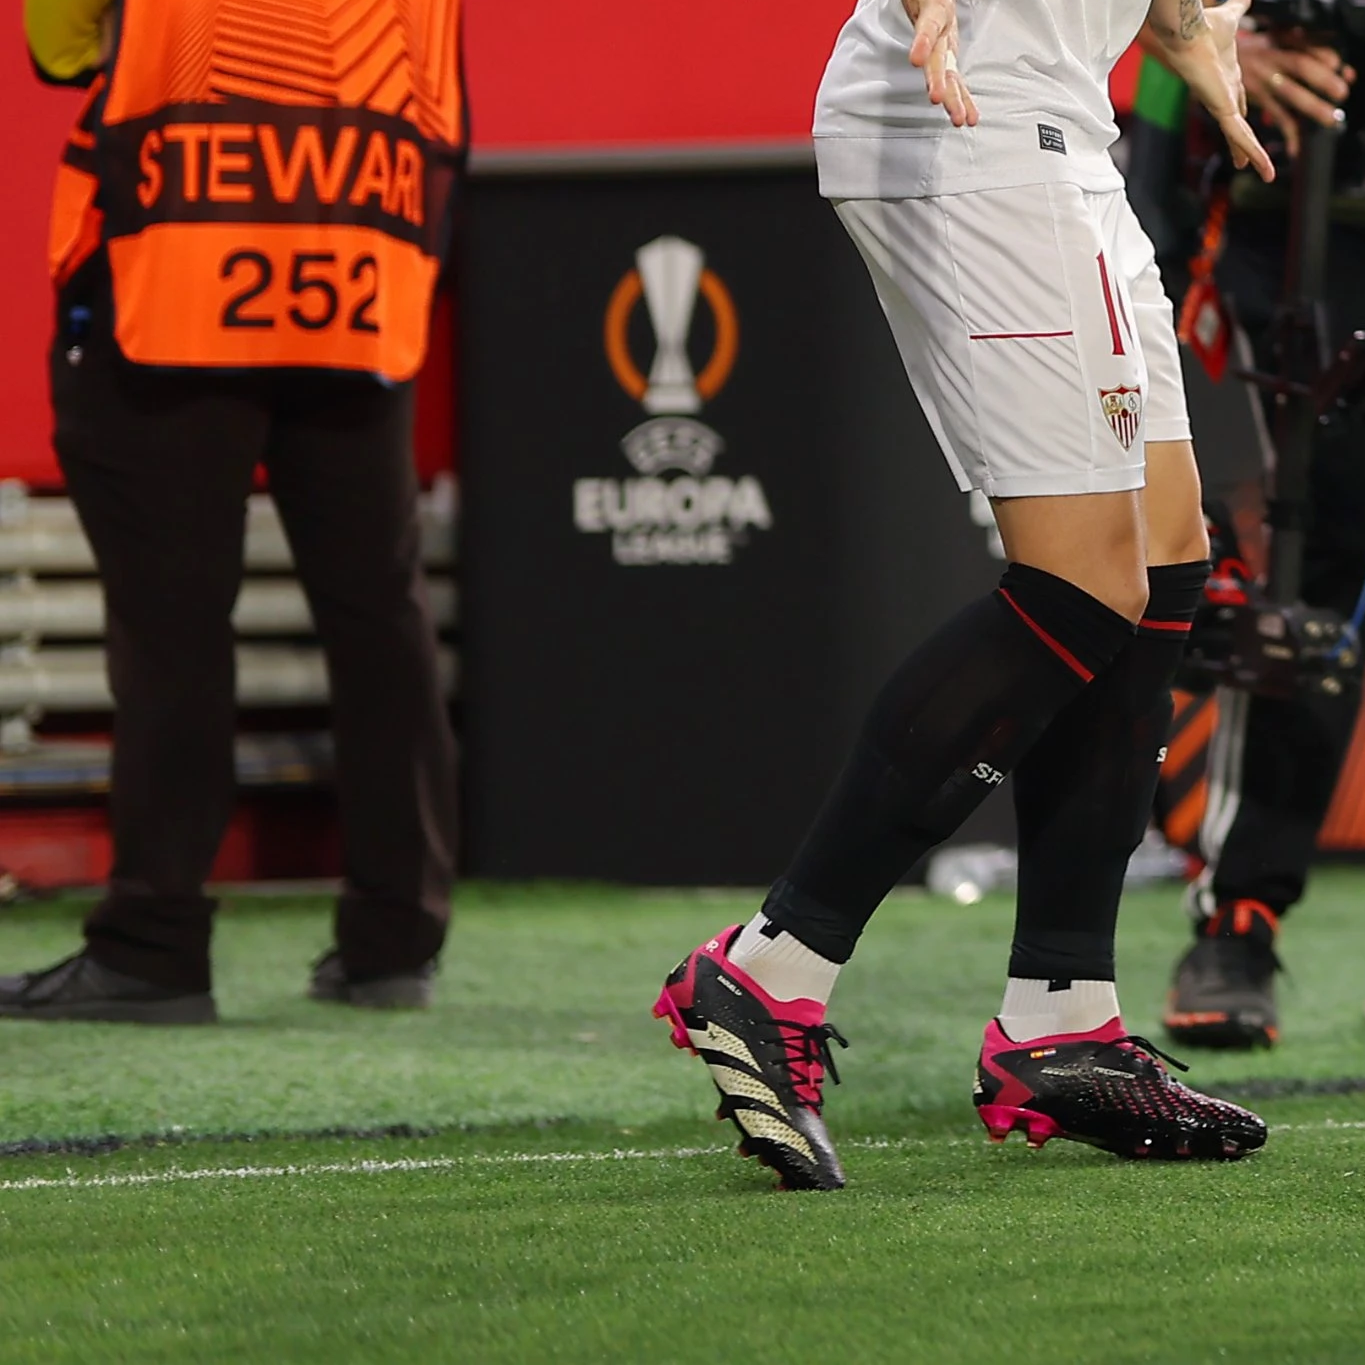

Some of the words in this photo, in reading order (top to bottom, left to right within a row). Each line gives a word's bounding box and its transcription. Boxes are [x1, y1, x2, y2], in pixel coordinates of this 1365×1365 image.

[219, 247, 381, 333] 252
[572, 476, 773, 533] EUROPA
[971, 762, 1007, 786] SF
